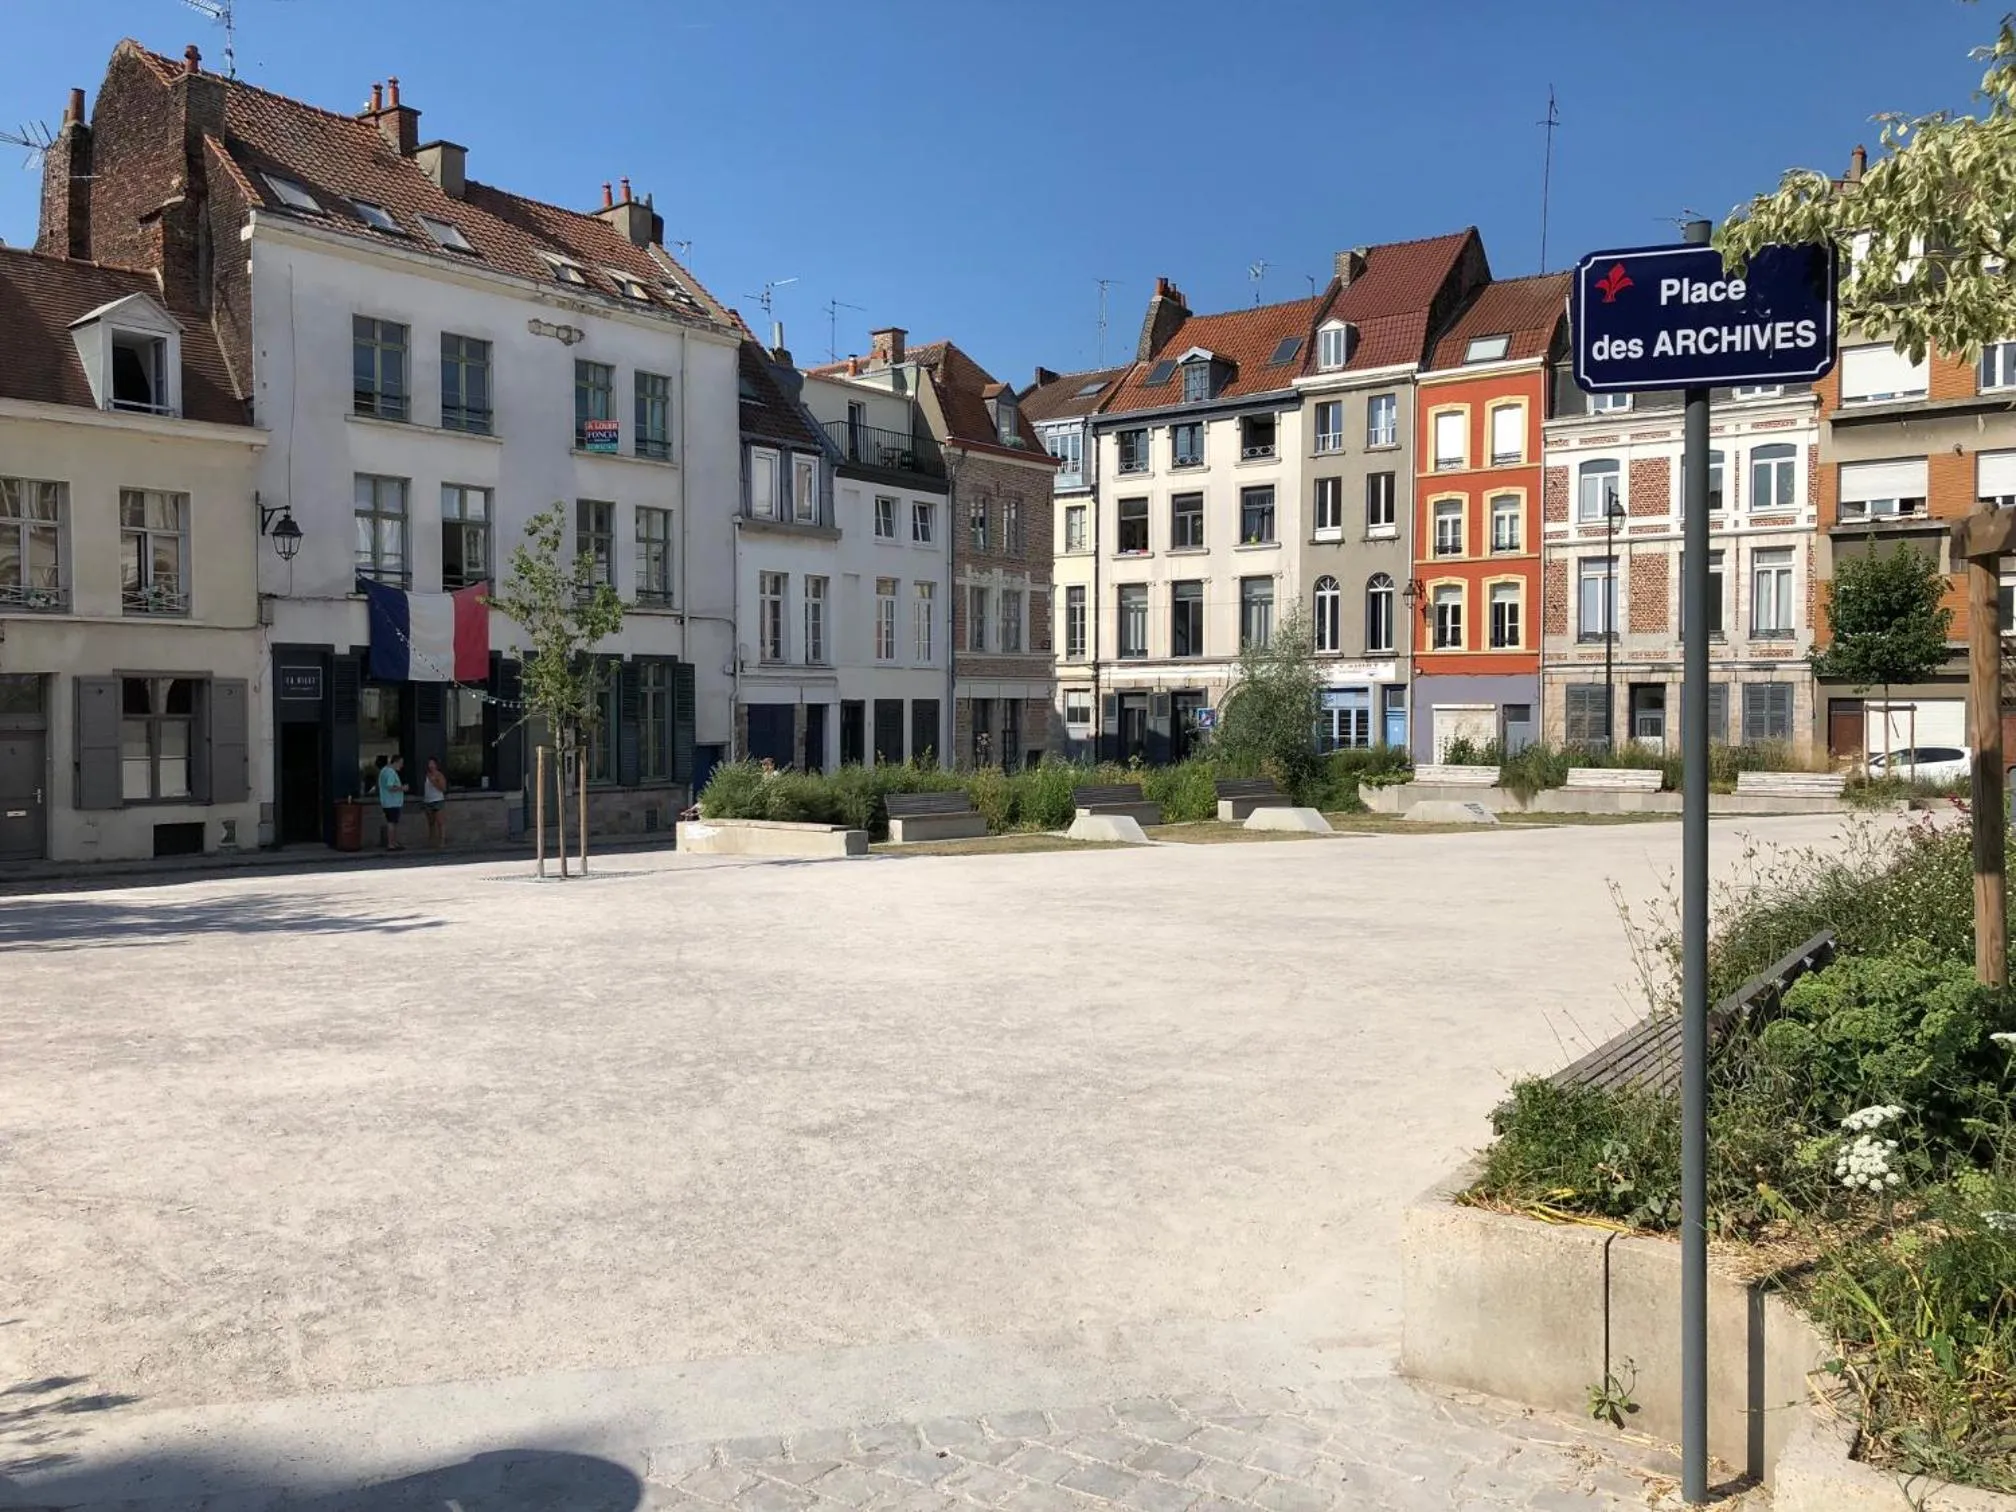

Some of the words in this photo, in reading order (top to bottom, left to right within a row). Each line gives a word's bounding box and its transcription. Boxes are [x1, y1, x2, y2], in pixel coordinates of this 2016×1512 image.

[1660, 278, 1746, 306] Place
[1591, 334, 1643, 361] des
[1652, 319, 1817, 357] ARCHIVES
